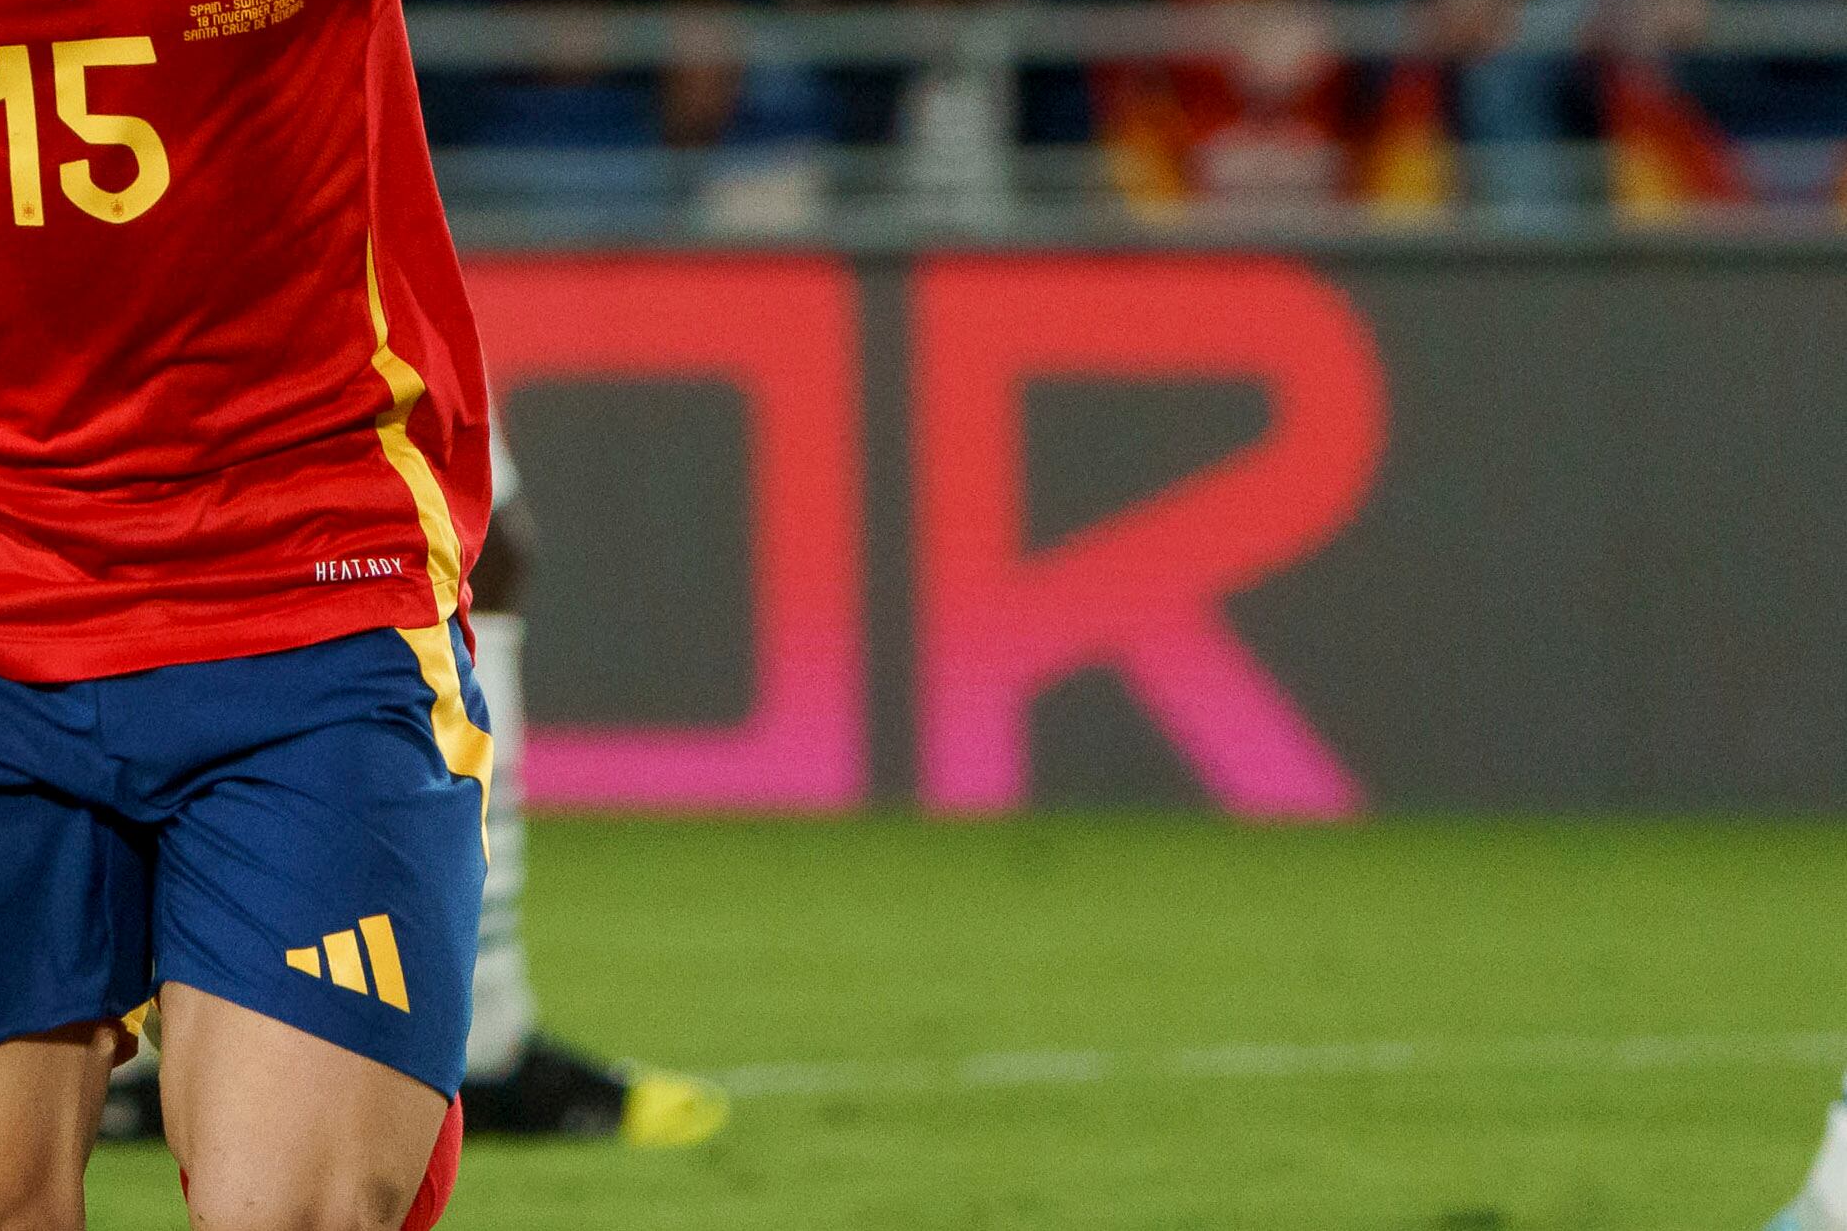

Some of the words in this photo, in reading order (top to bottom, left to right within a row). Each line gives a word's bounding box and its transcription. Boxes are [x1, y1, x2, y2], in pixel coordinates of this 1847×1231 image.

[189, 1, 222, 17] SPAIN
[197, 16, 209, 28] 18
[213, 4, 271, 26] NOVEMBER
[183, 26, 219, 42] SANTA
[222, 21, 251, 37] CRUZ
[254, 15, 267, 30] DE
[315, 557, 402, 582] HEAT.RDY
